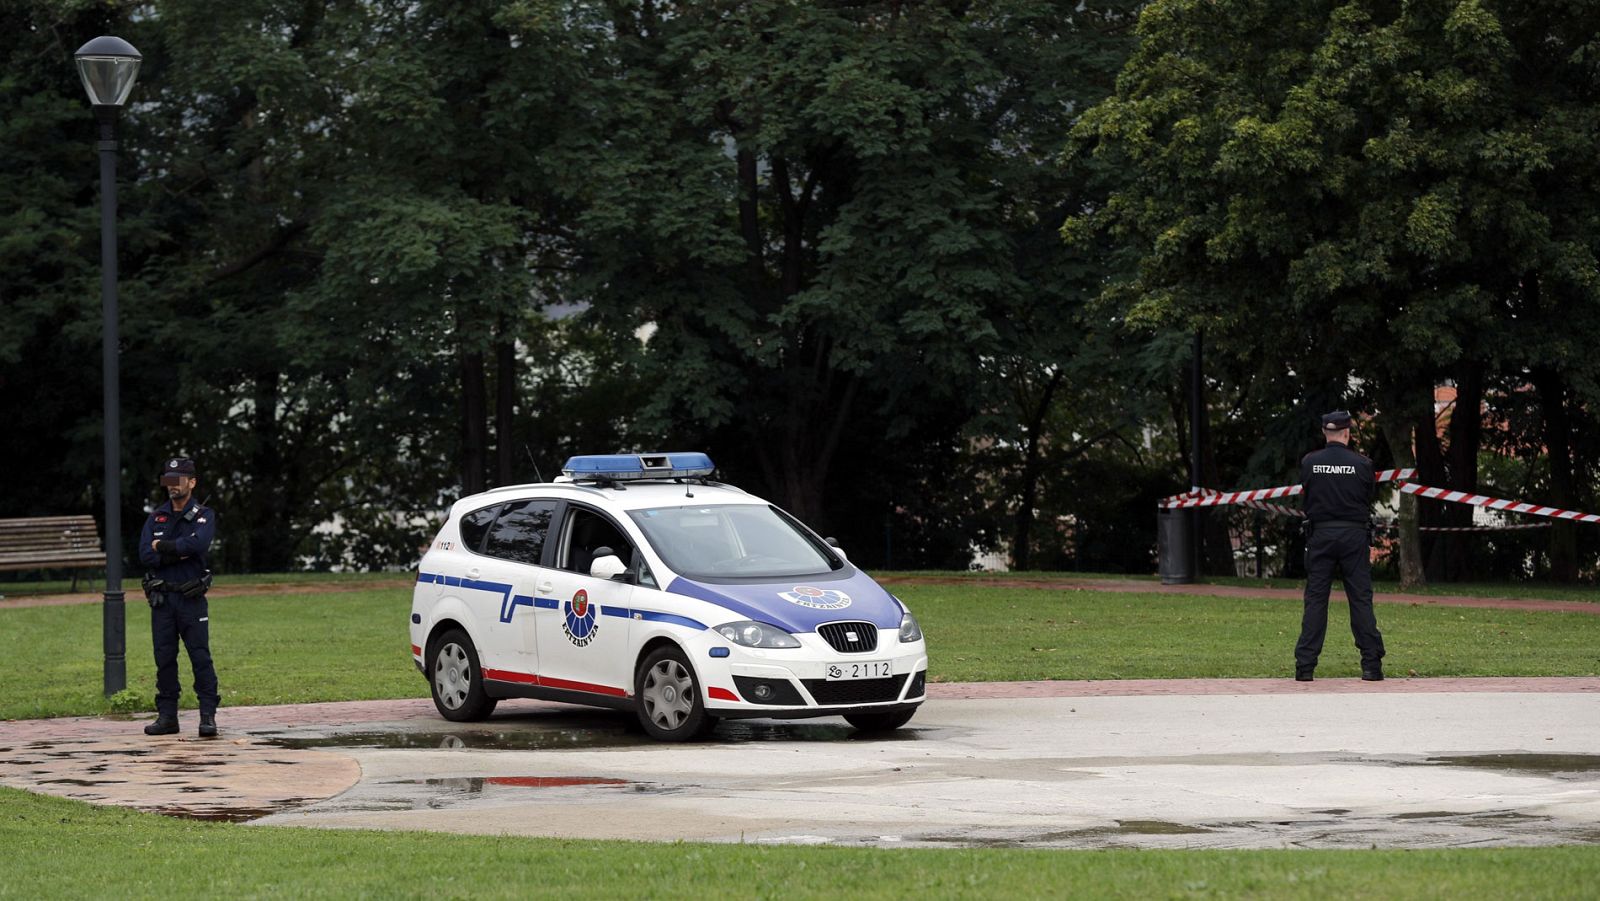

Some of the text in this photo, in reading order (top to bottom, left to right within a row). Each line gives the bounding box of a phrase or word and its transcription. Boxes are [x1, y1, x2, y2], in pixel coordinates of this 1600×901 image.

[1313, 465, 1356, 474] ERTZAINTZA
[562, 622, 599, 648] ERTZAINTZA
[851, 662, 889, 678] 2112
